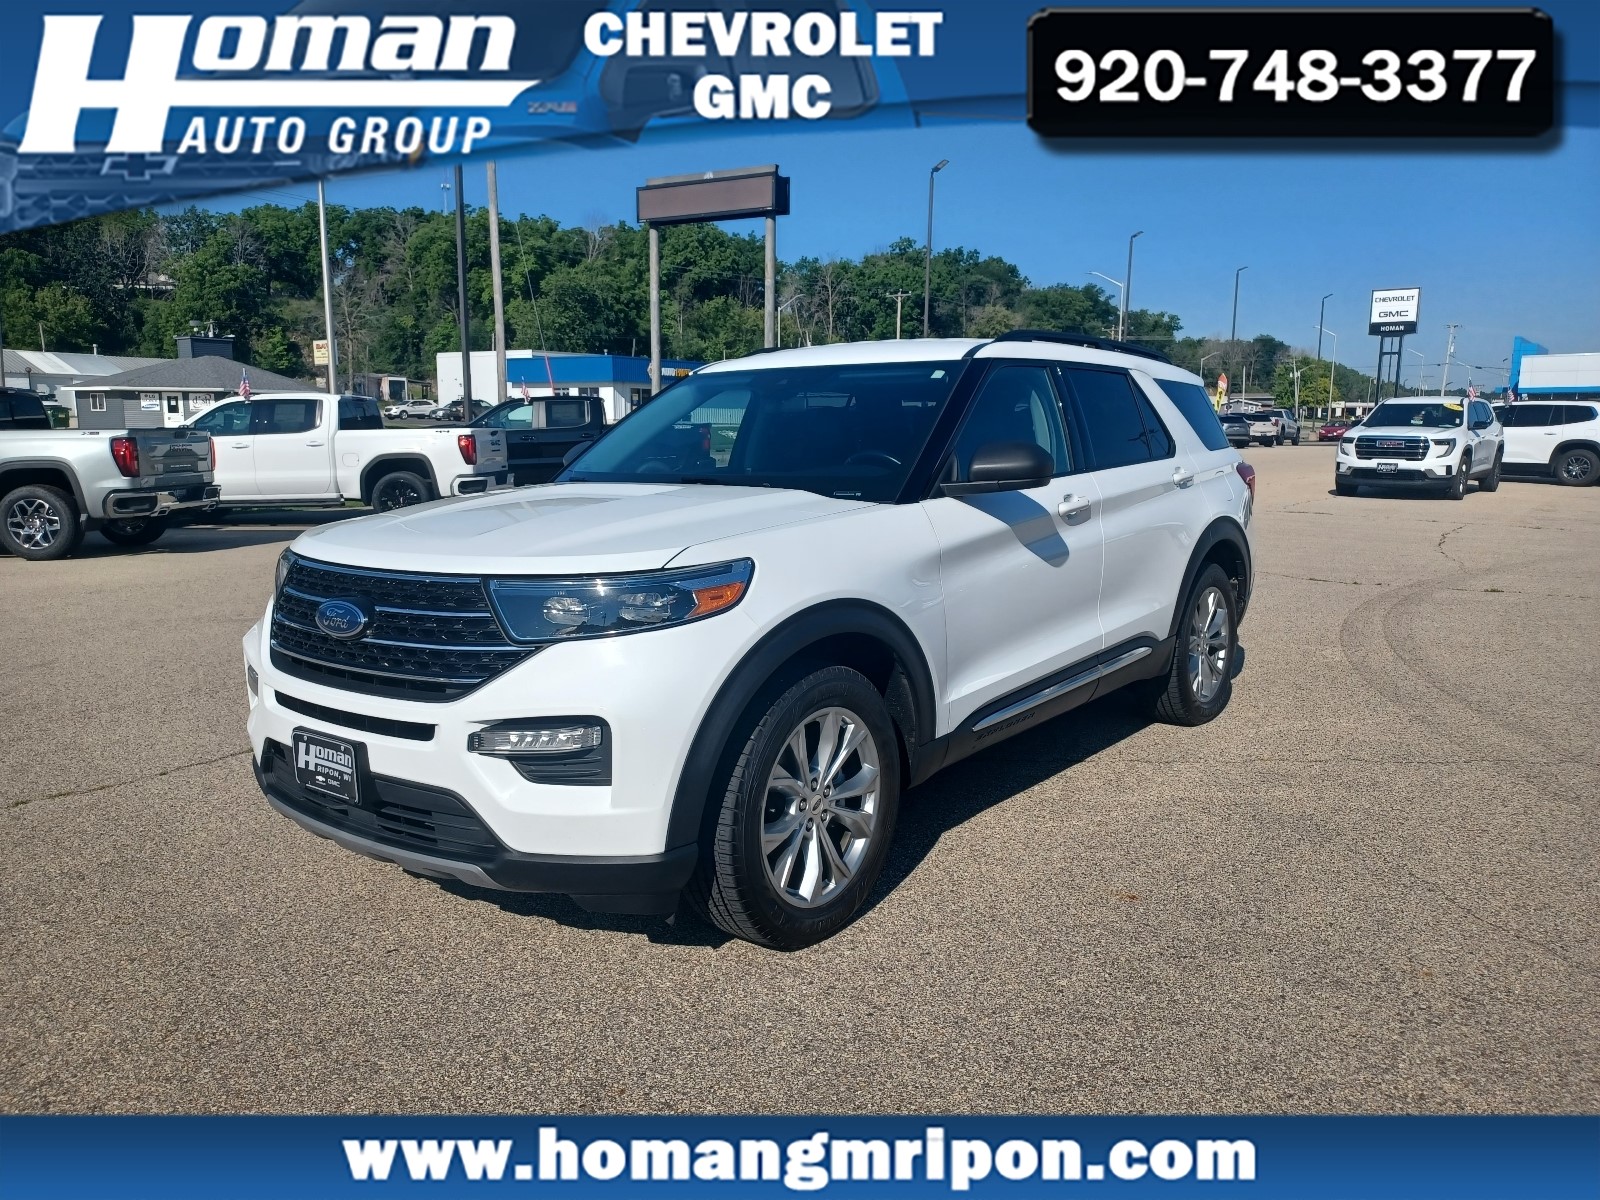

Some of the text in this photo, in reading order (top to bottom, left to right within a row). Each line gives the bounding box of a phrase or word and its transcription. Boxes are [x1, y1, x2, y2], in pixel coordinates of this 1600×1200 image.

[1374, 295, 1415, 303] CHEVROLET
[1378, 310, 1409, 318] GMC
[323, 607, 351, 629] Ford
[297, 741, 353, 772] Homan
[316, 765, 341, 780] RIPON,
[327, 778, 341, 788] GMC
